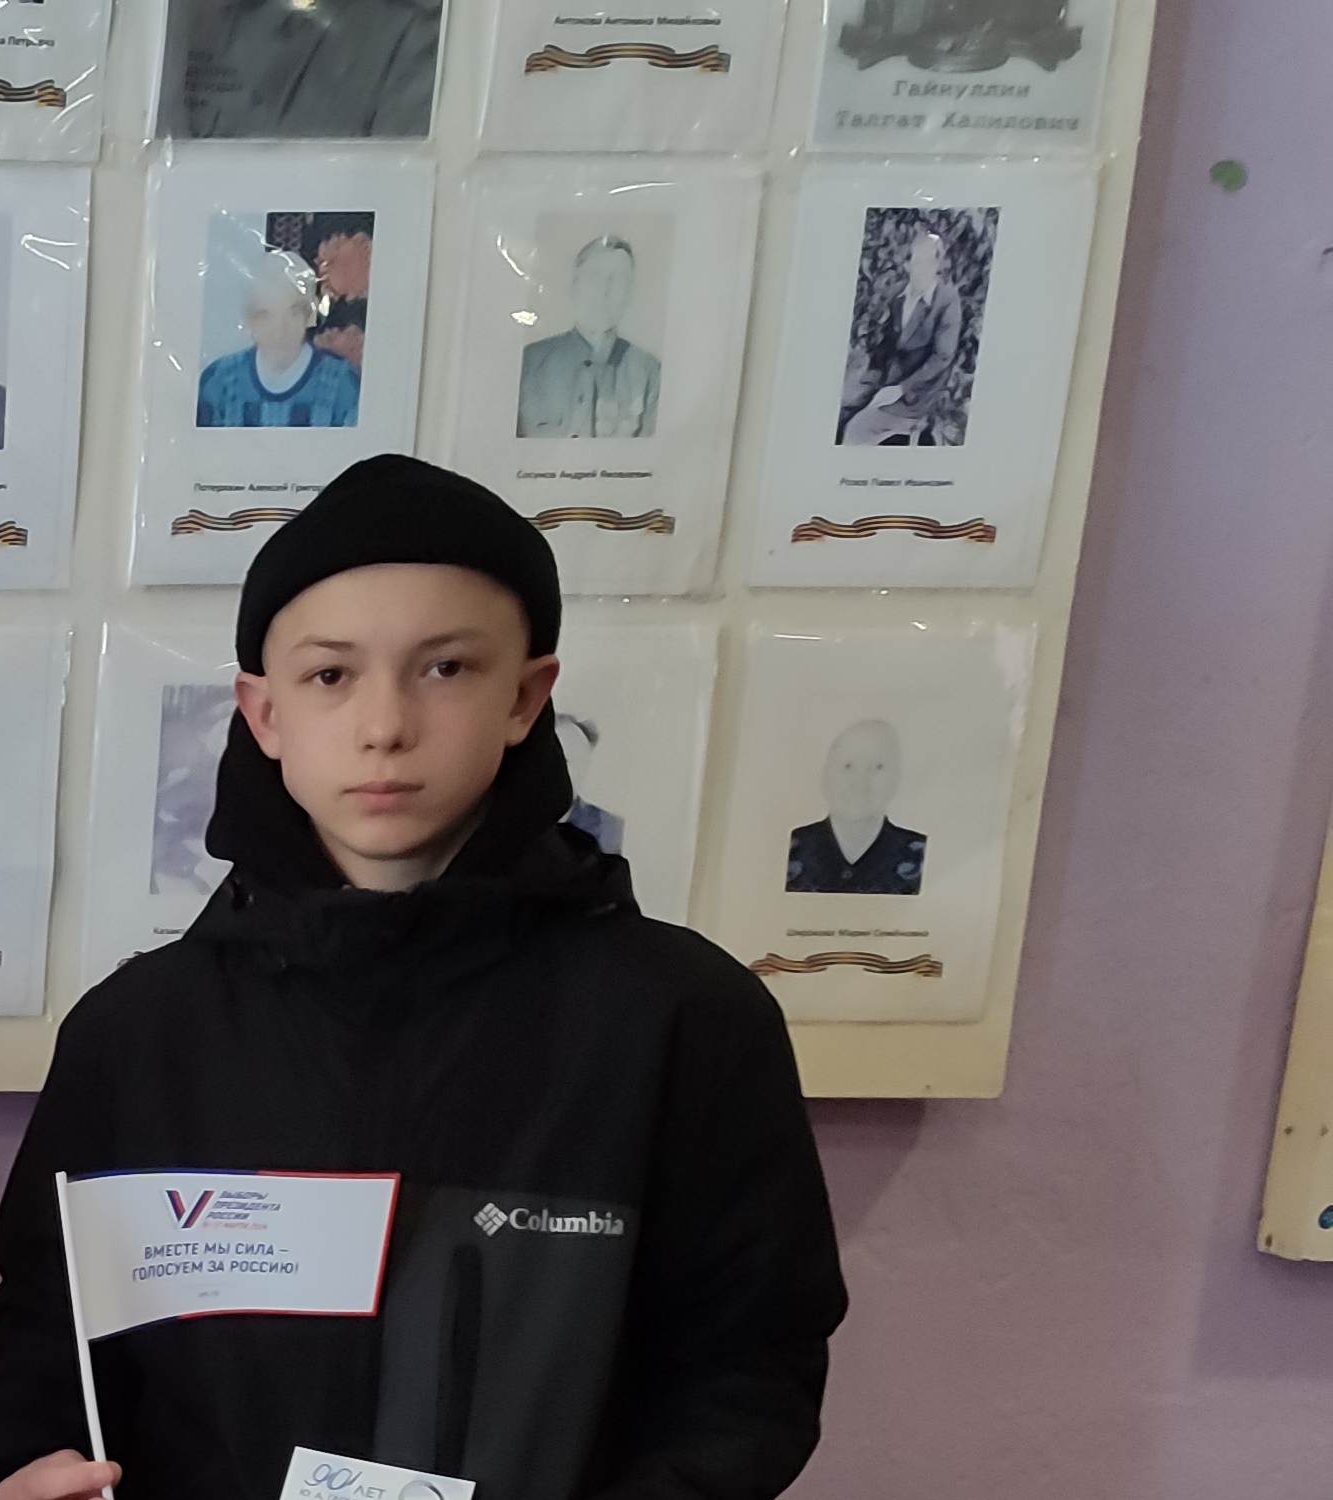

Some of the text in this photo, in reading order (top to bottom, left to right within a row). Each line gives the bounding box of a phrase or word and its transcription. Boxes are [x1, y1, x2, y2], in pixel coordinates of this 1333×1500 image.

[892, 79, 1030, 100] Гайнуллин
[835, 110, 926, 129] Талгат
[509, 1207, 625, 1235] Columbia
[144, 1242, 199, 1260] ВМЕСТЕ
[204, 1242, 230, 1255] МЫ
[235, 1243, 274, 1256] СИЛА
[132, 1260, 299, 1282] ГОЛОСУЕМ ЗА РОССИЮ!
[353, 1485, 386, 1500] ЛЕТ
